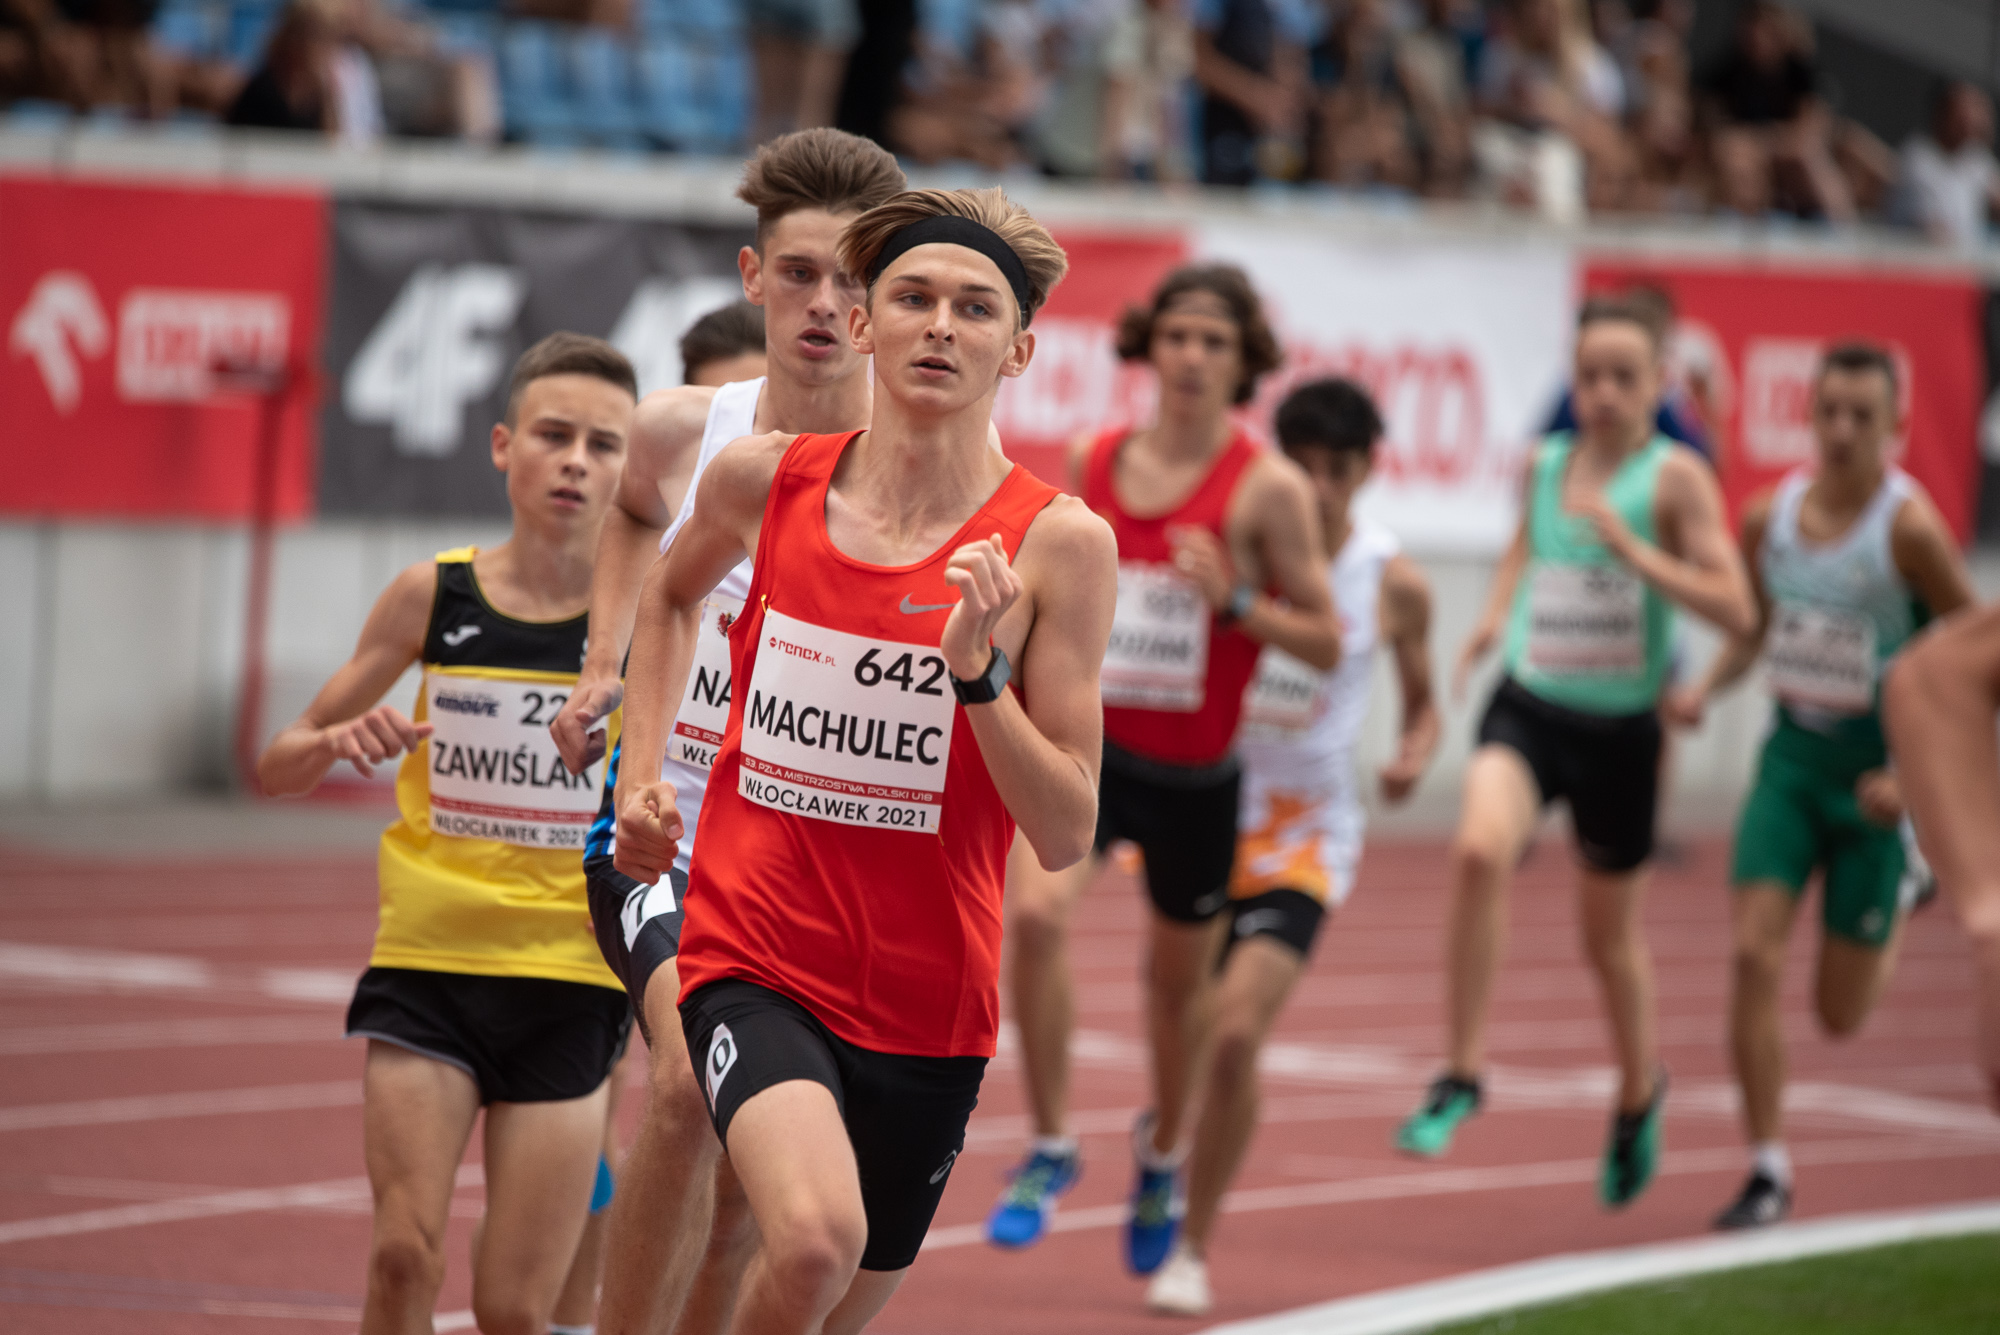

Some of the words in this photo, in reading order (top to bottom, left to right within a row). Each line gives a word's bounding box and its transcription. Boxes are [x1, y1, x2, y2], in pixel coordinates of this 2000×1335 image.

[346, 264, 520, 456] 4F
[854, 647, 946, 697] 642
[749, 689, 943, 766] MACHULEC
[745, 757, 757, 770] 53.
[758, 762, 782, 777] PZLA
[783, 770, 865, 795] MISTRZOSTWA
[867, 786, 909, 799] POLSKI
[911, 792, 933, 802] U18
[745, 775, 870, 822] WŁOCŁAWEK
[876, 805, 926, 828] 2021
